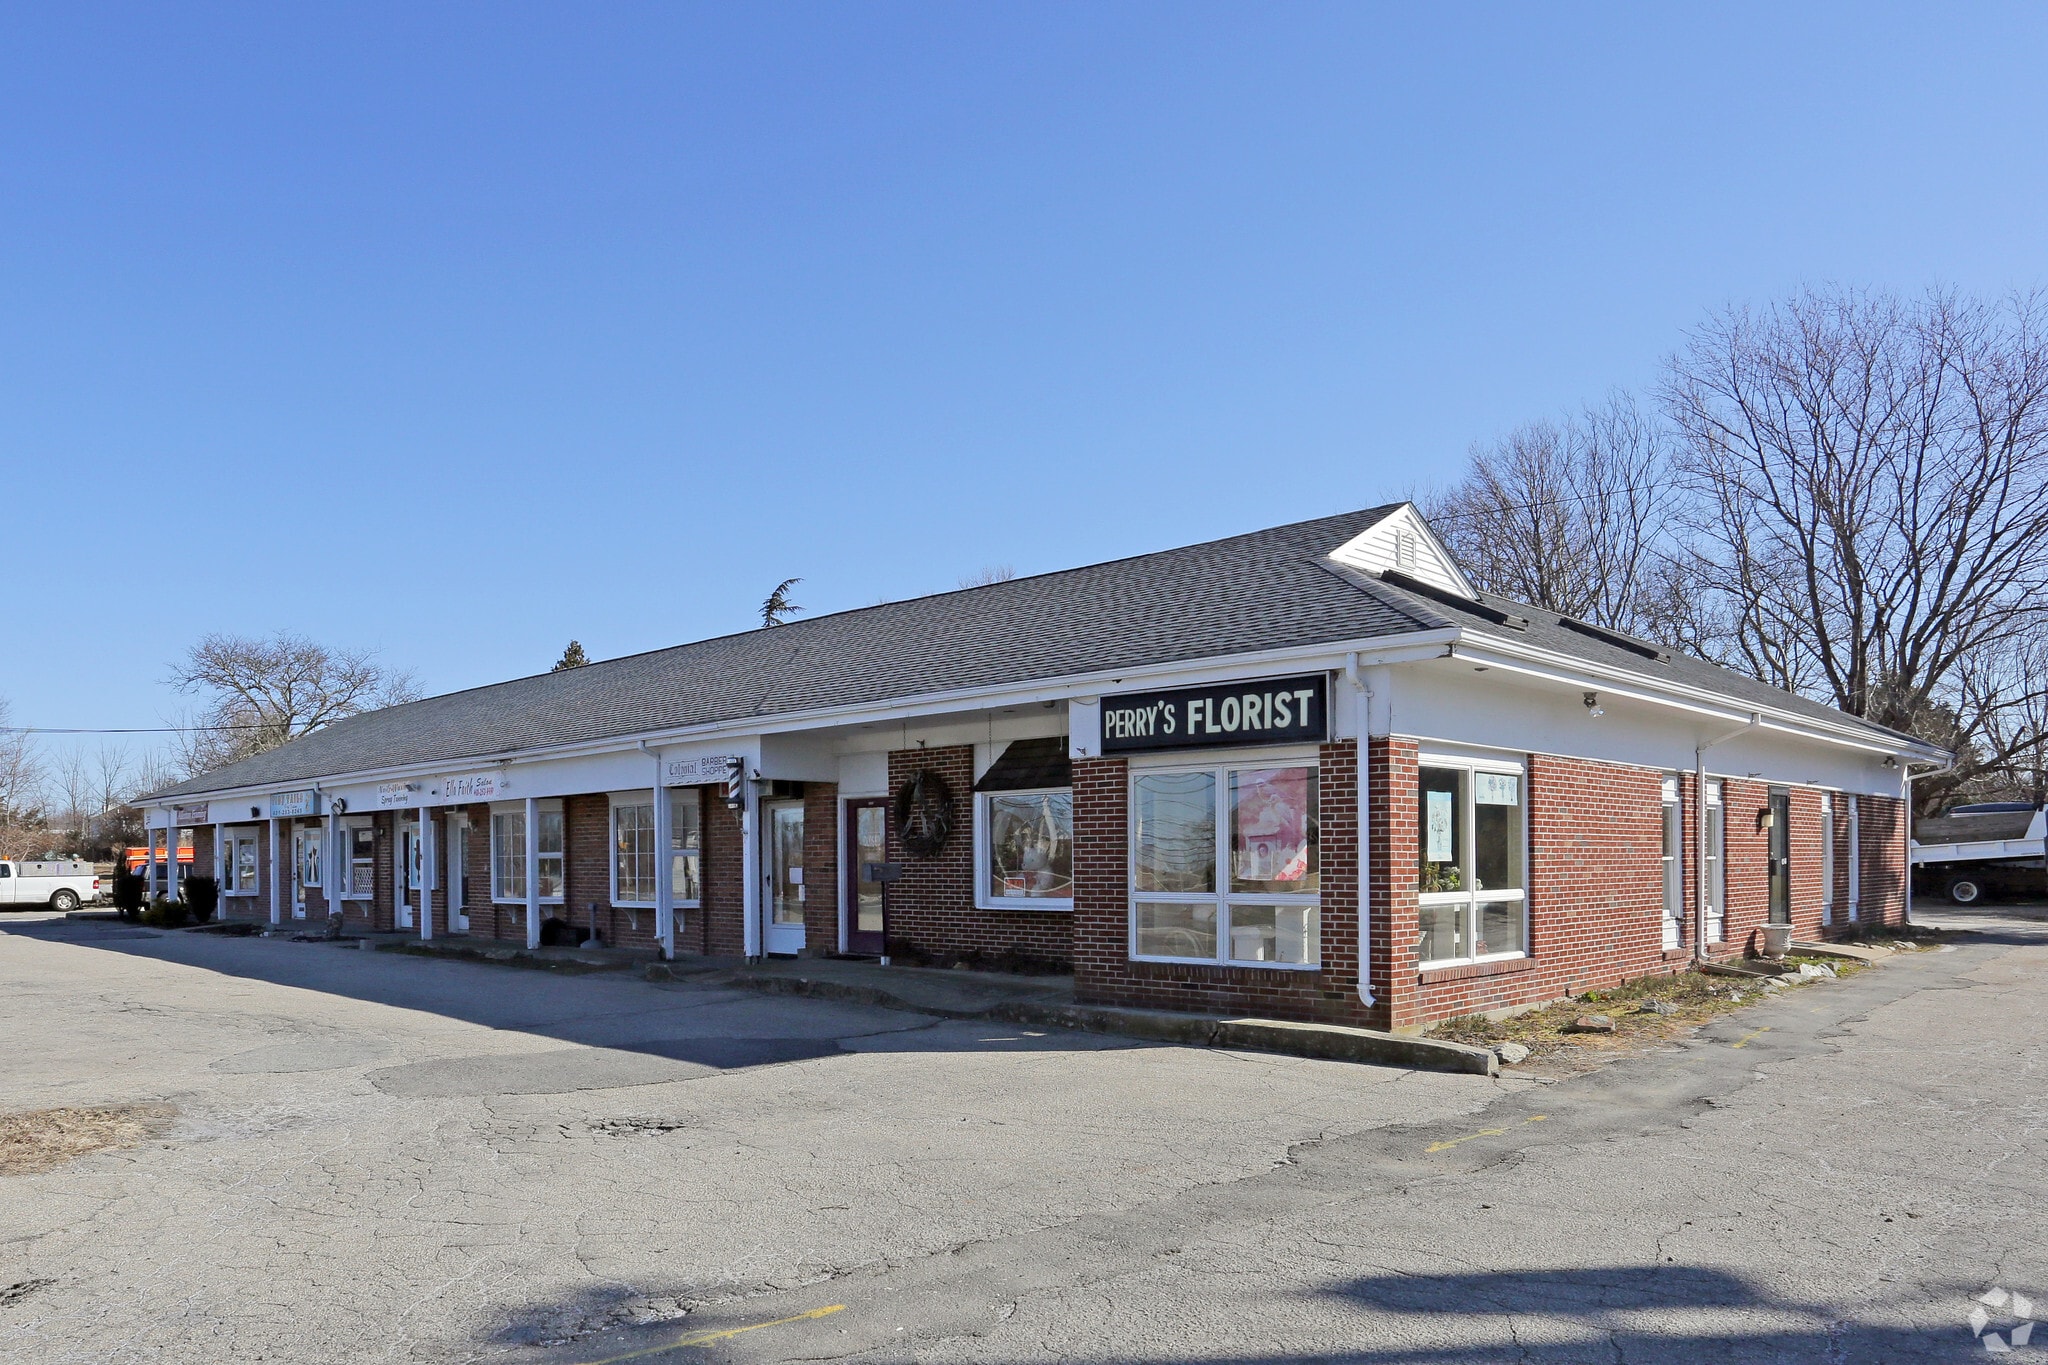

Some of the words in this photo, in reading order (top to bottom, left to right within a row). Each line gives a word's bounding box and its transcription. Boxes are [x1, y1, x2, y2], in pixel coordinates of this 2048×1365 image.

[1105, 700, 1176, 739] PERRY'S
[1187, 689, 1314, 735] FLORIST
[701, 756, 727, 767] BARBER
[669, 762, 697, 776] Colonial
[701, 766, 727, 776] SHOPPE
